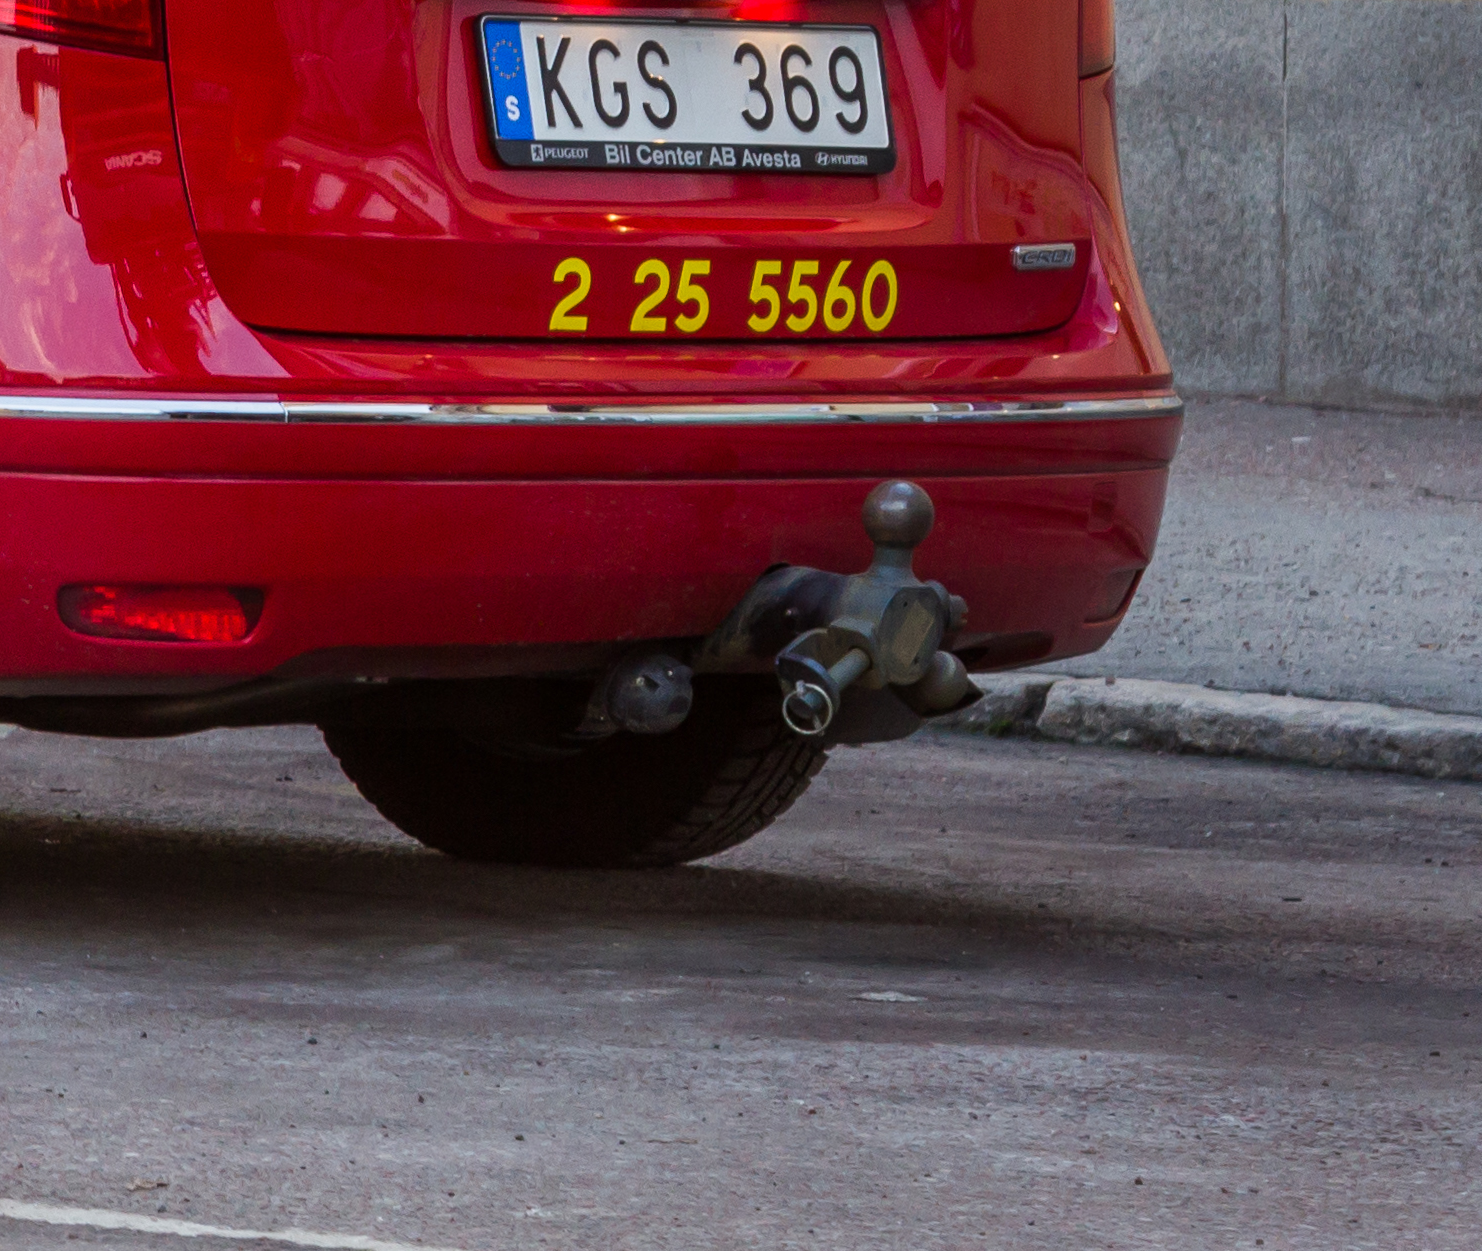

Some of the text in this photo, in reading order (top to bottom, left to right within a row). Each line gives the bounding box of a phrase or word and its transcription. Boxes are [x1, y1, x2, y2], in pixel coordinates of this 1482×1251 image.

[504, 34, 869, 135] S KGS 369
[544, 144, 868, 168] PEUGEOT Bil Center AB Avesta HYUNDAI
[549, 256, 900, 333] 2 25 5560
